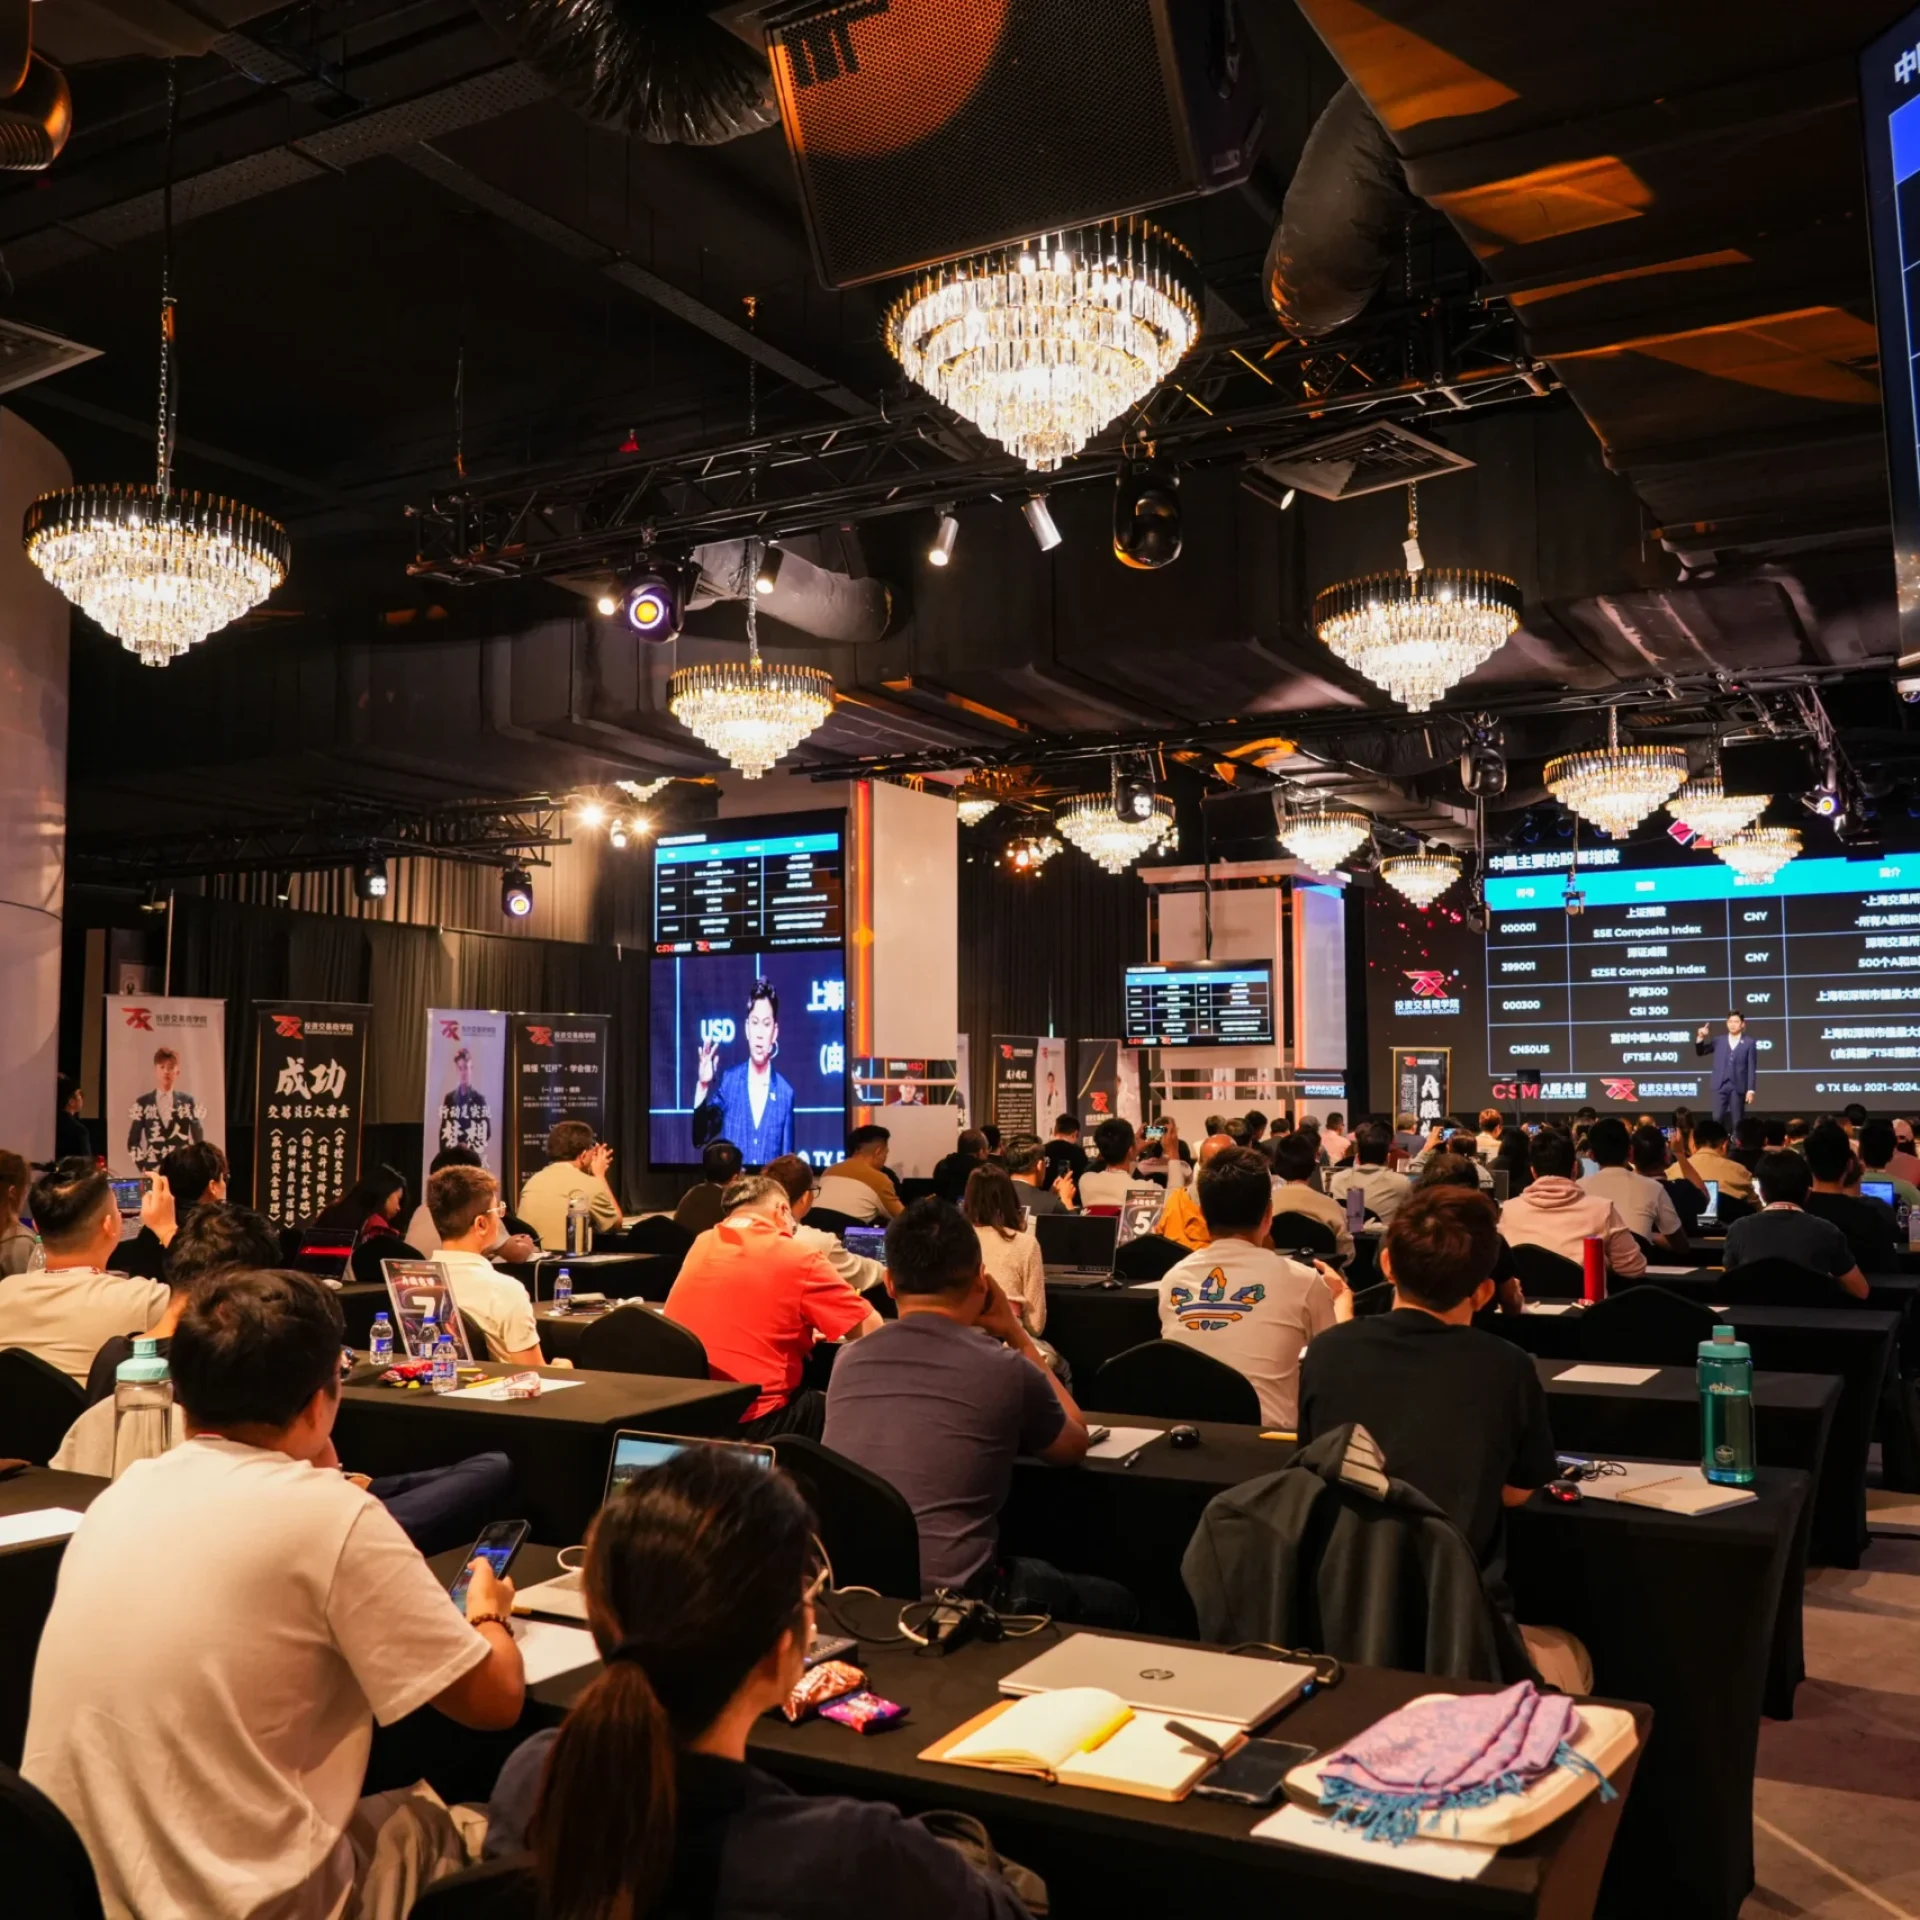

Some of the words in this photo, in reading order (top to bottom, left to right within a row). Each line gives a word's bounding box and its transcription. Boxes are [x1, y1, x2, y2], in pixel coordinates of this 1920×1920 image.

[1894, 42, 1920, 84] 中
[1743, 911, 1767, 921] CNY
[1854, 914, 1920, 927] -所有A股和B
[1500, 923, 1536, 933] 000001
[1593, 928, 1612, 938] SSE
[1614, 926, 1670, 939] Composite
[1672, 924, 1701, 934] Index
[1745, 952, 1769, 962] CNY
[1501, 962, 1536, 972] 399001
[1591, 967, 1617, 978] SZSE
[1619, 965, 1674, 979] Composite
[1676, 964, 1706, 974] Index
[1746, 992, 1770, 1003] CNY
[1502, 1000, 1540, 1010] 000300
[1629, 1006, 1646, 1016] CSI
[1648, 1006, 1668, 1016] 300
[700, 1019, 736, 1043] USD
[1821, 1026, 1920, 1040] 上海和深圳市值最大
[1509, 1044, 1550, 1055] CN50US
[1622, 1052, 1651, 1063] (FTSE
[1653, 1051, 1678, 1063] A50)
[275, 1056, 347, 1100] 成功
[1492, 1083, 1539, 1099] CSM
[1827, 1083, 1840, 1092] TX
[1843, 1083, 1862, 1092] Edu
[148, 1121, 189, 1143] 主人
[441, 1119, 489, 1154] 梦想
[1133, 1211, 1151, 1235] 5
[412, 1296, 436, 1320] 7
